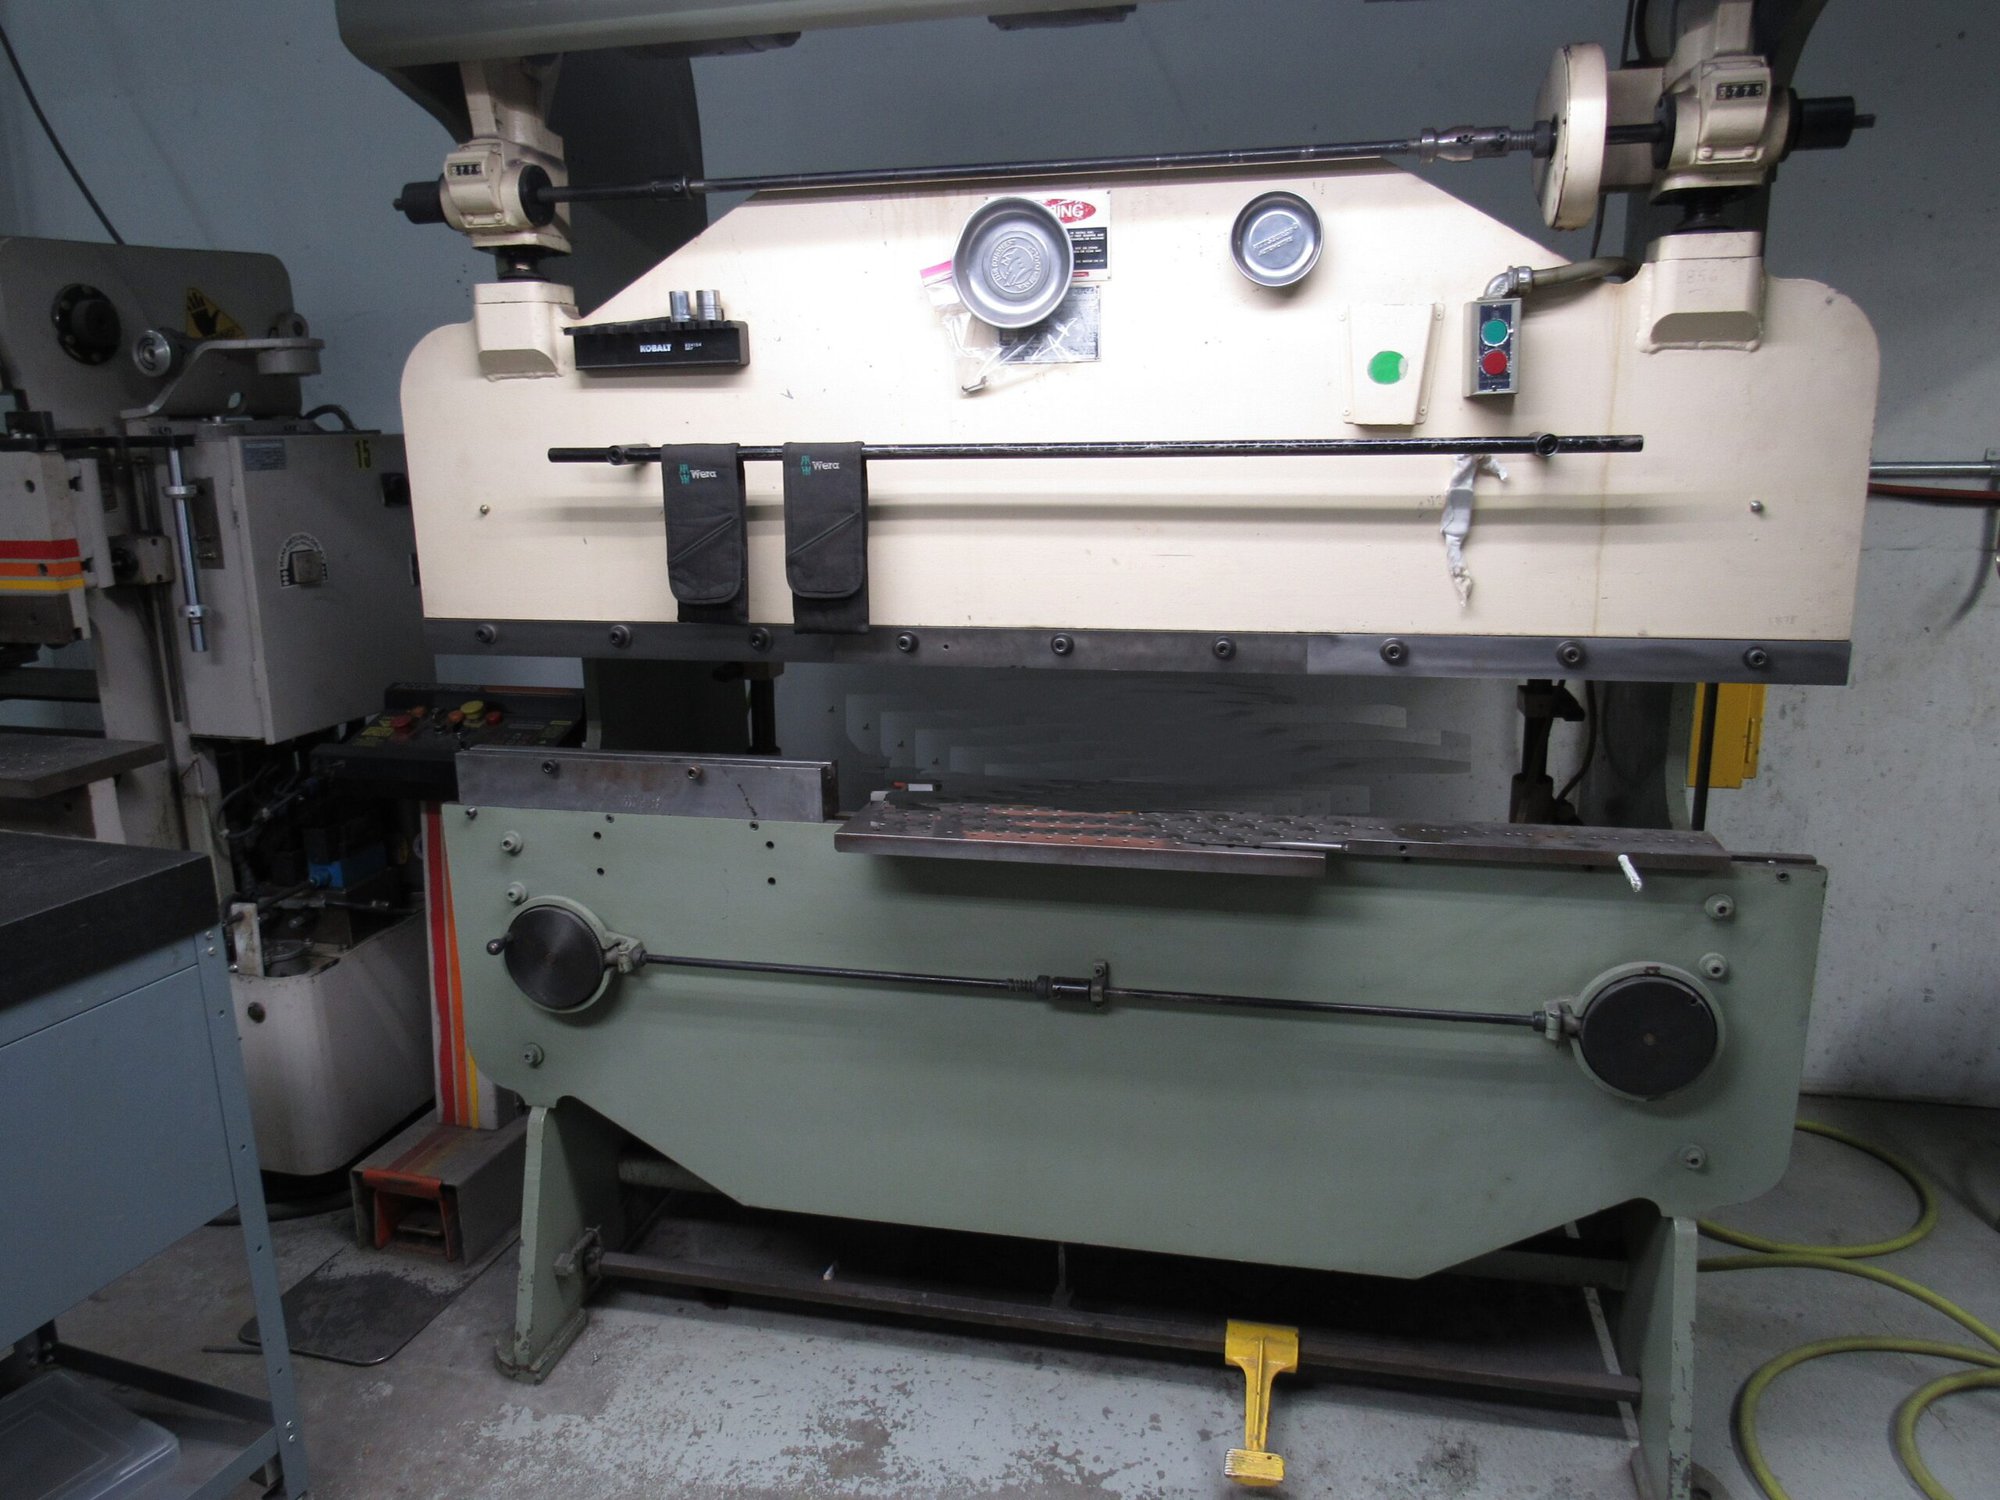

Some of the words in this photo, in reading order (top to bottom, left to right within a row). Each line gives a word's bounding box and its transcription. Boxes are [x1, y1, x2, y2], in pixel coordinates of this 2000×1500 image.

[640, 343, 672, 353] KOBALT
[354, 439, 372, 468] 15
[811, 461, 840, 471] Wera
[690, 469, 717, 479] Wera
